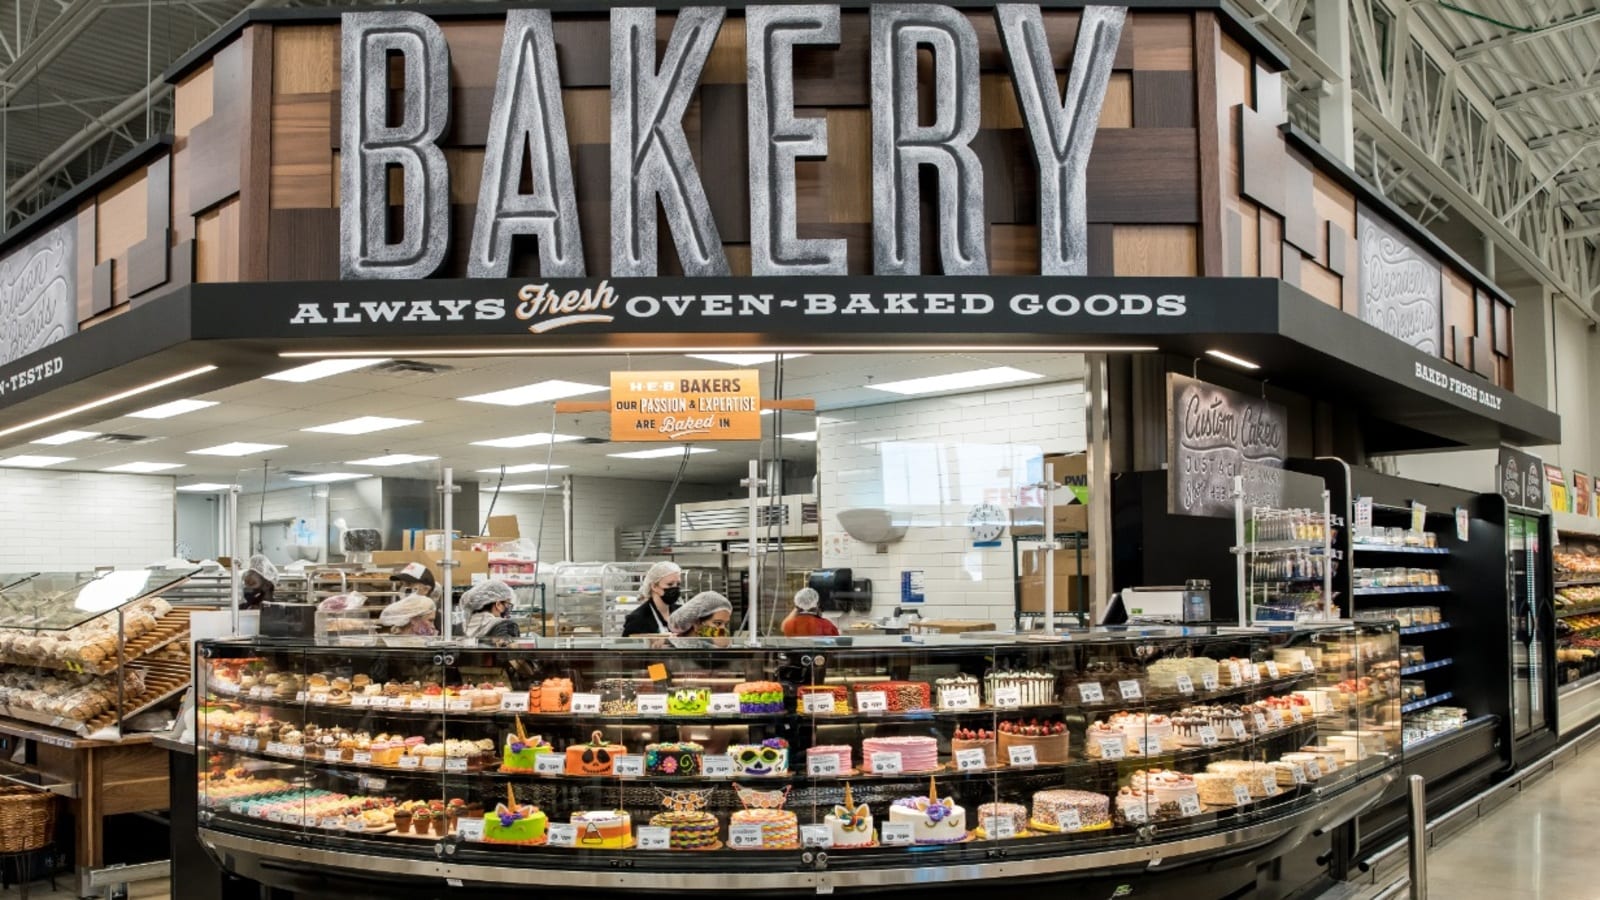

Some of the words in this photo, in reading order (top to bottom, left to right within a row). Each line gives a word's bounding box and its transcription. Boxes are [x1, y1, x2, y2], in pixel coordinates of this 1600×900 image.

[340, 3, 1127, 278] BAKERY
[290, 298, 505, 324] ALWAYS
[515, 280, 619, 323] Fresh
[1009, 294, 1187, 316] GOODS
[680, 378, 741, 393] BAKERS
[1415, 361, 1448, 389] BAKED
[1449, 377, 1478, 401] FRESH
[1479, 391, 1502, 410] DAILY
[616, 401, 637, 410] OUR
[640, 397, 686, 413] PASSION
[698, 396, 756, 412] EXPERTISE
[635, 419, 656, 429] ARE
[659, 415, 715, 433] Baked
[719, 418, 730, 428] IN
[1185, 394, 1238, 441] Custom
[1241, 405, 1282, 449] Cakes
[1185, 455, 1216, 475] JUST
